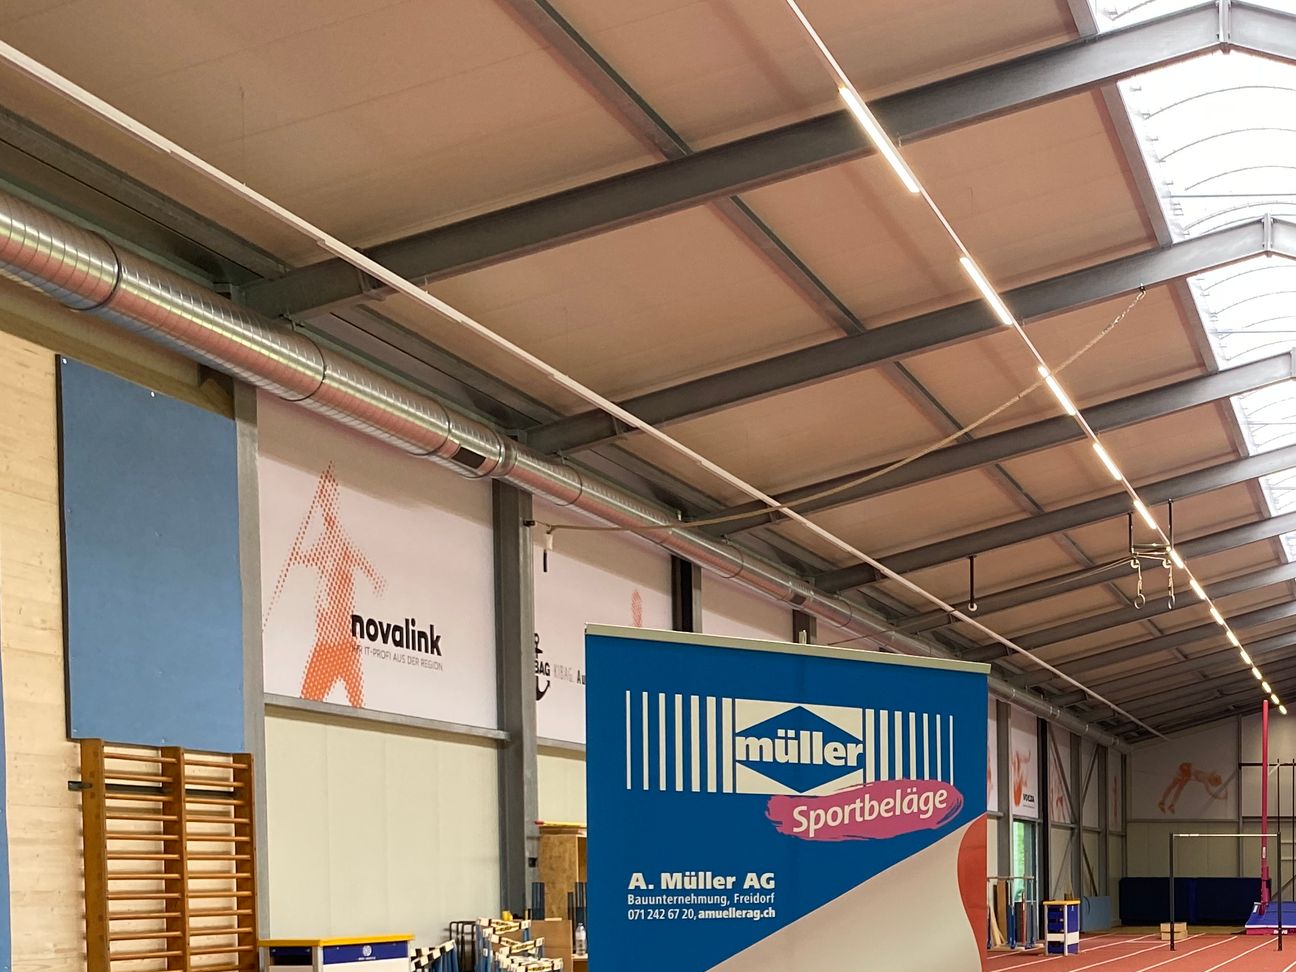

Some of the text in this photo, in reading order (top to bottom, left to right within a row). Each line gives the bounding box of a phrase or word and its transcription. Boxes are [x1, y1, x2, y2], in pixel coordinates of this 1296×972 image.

[351, 614, 442, 656] novalink
[364, 646, 391, 660] IT-PROFI
[393, 653, 406, 664] AUS
[408, 655, 419, 667] DER
[421, 658, 443, 671] REGION
[535, 660, 550, 676] BAG
[736, 729, 863, 766] müller
[793, 787, 948, 837] Sportbeläge
[628, 872, 775, 890] A. Müller AG
[628, 893, 775, 907] Bauunternehmung, Freidorf
[628, 907, 776, 921] 071 242 67 20, amuellerag.ch
